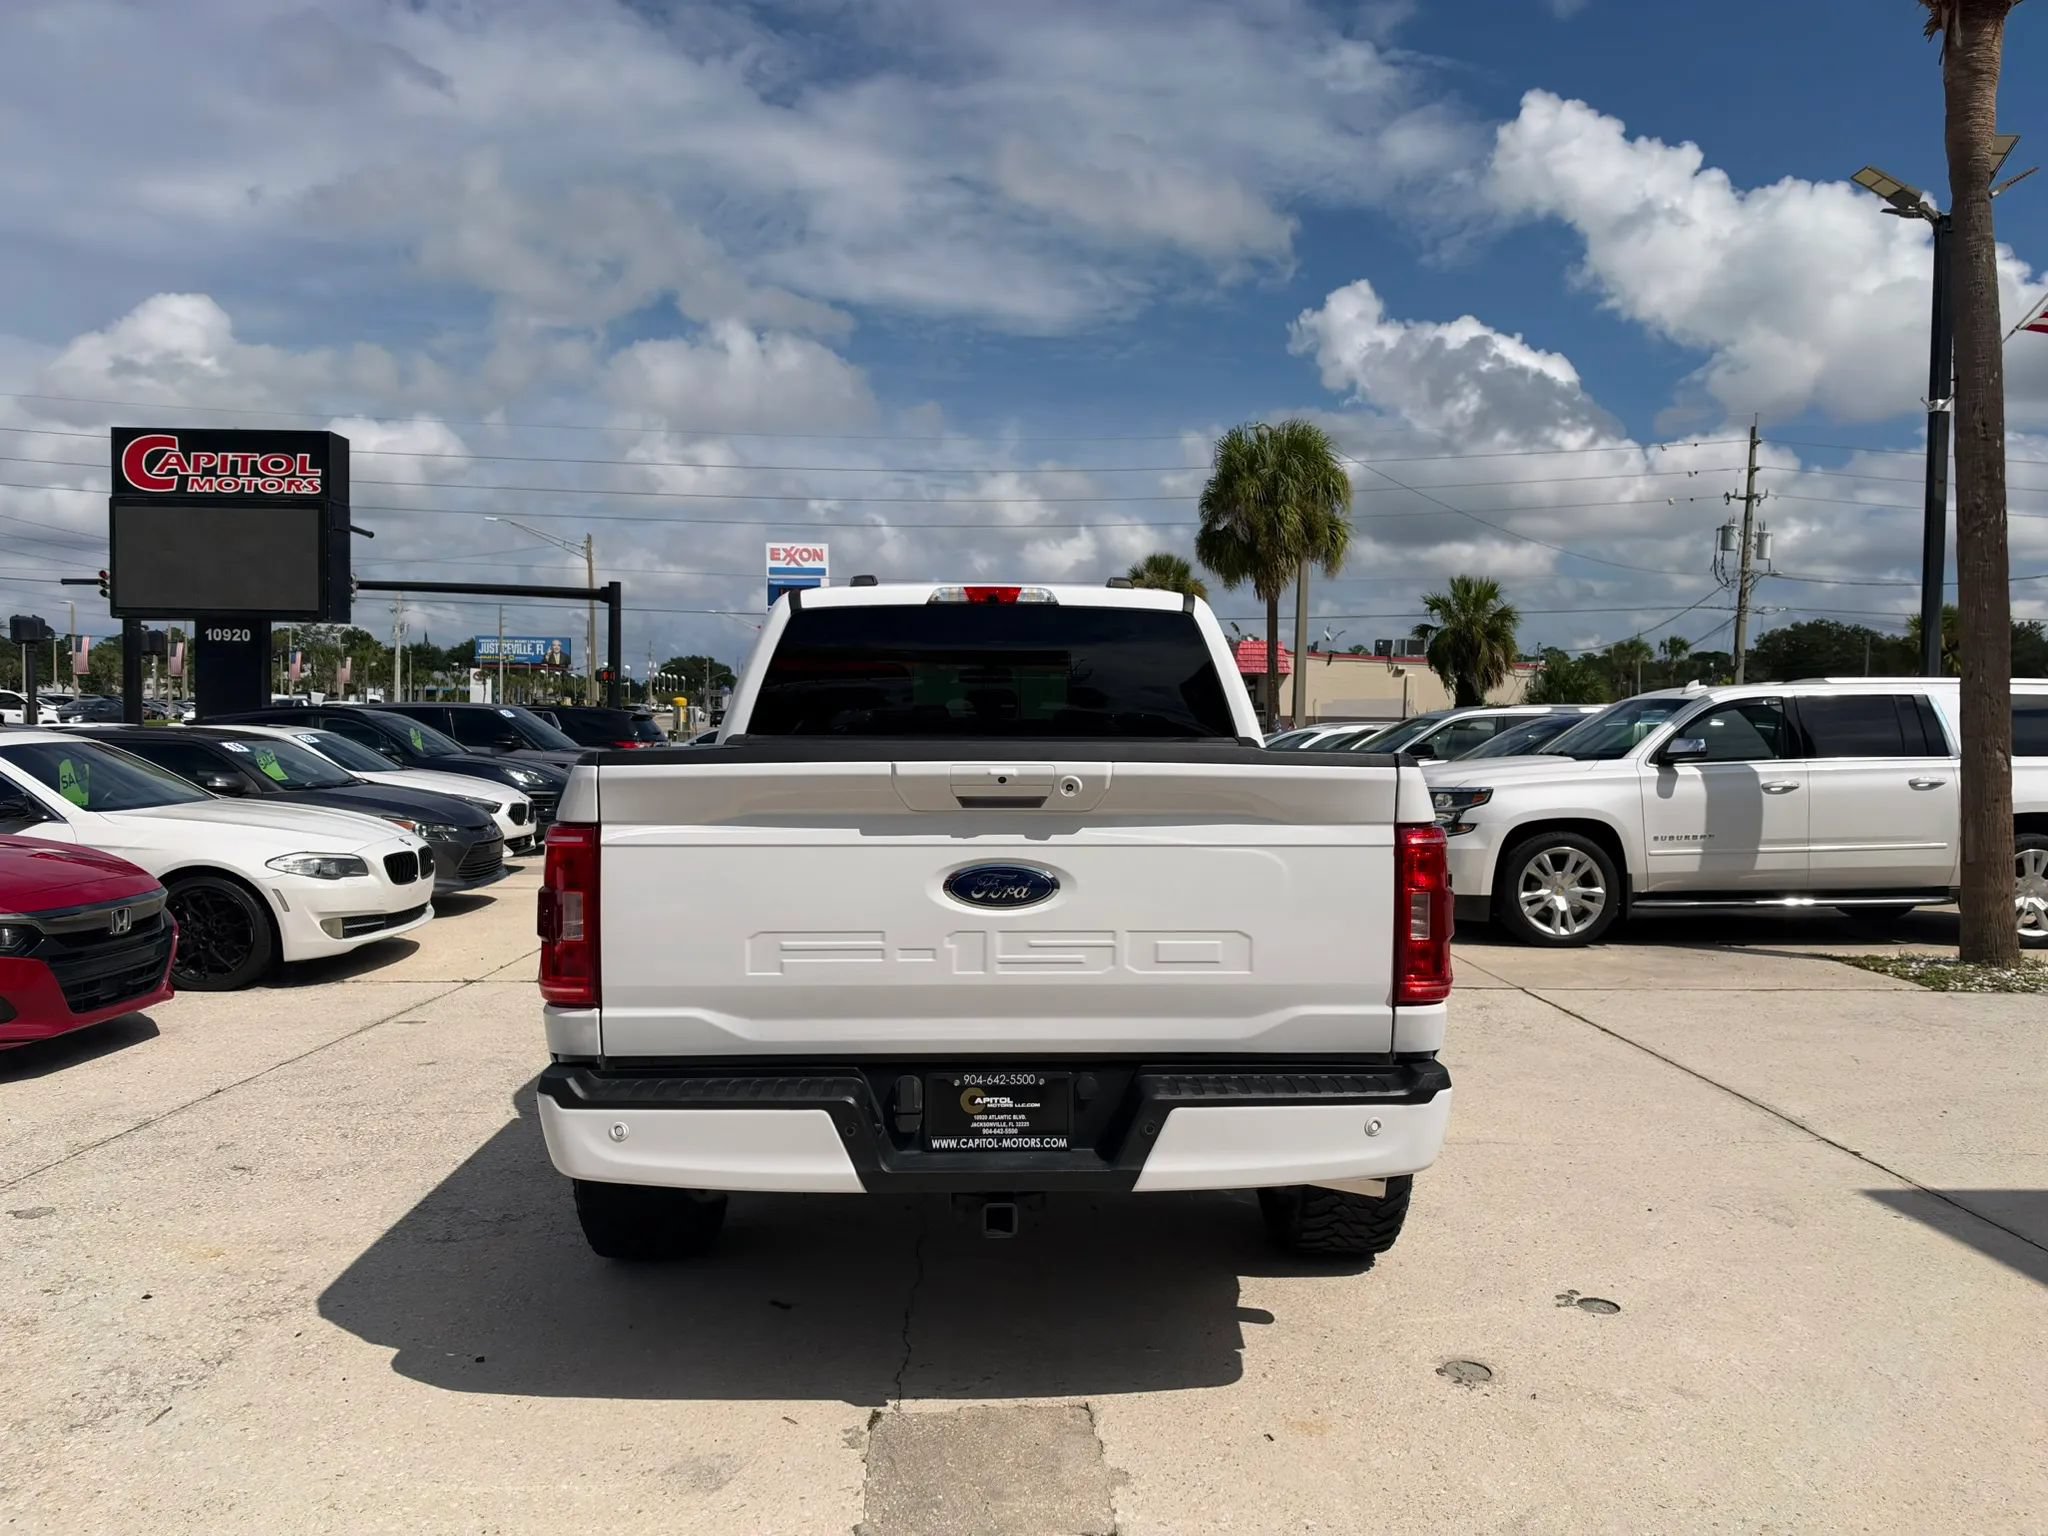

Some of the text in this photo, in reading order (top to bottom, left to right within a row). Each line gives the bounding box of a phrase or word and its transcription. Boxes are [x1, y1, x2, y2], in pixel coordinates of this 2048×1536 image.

[121, 434, 322, 492] CAPITOL
[187, 477, 321, 494] MOTORS
[769, 546, 824, 567] EXXON
[205, 628, 251, 641] 10920
[478, 643, 534, 656] JUSTCEVILLE,
[971, 873, 1033, 900] Ford
[745, 930, 1253, 976] F-150
[963, 1074, 1036, 1085] 904-642-5500
[931, 1138, 1068, 1149] WWW.CAPITOL-MOTORS.COM
